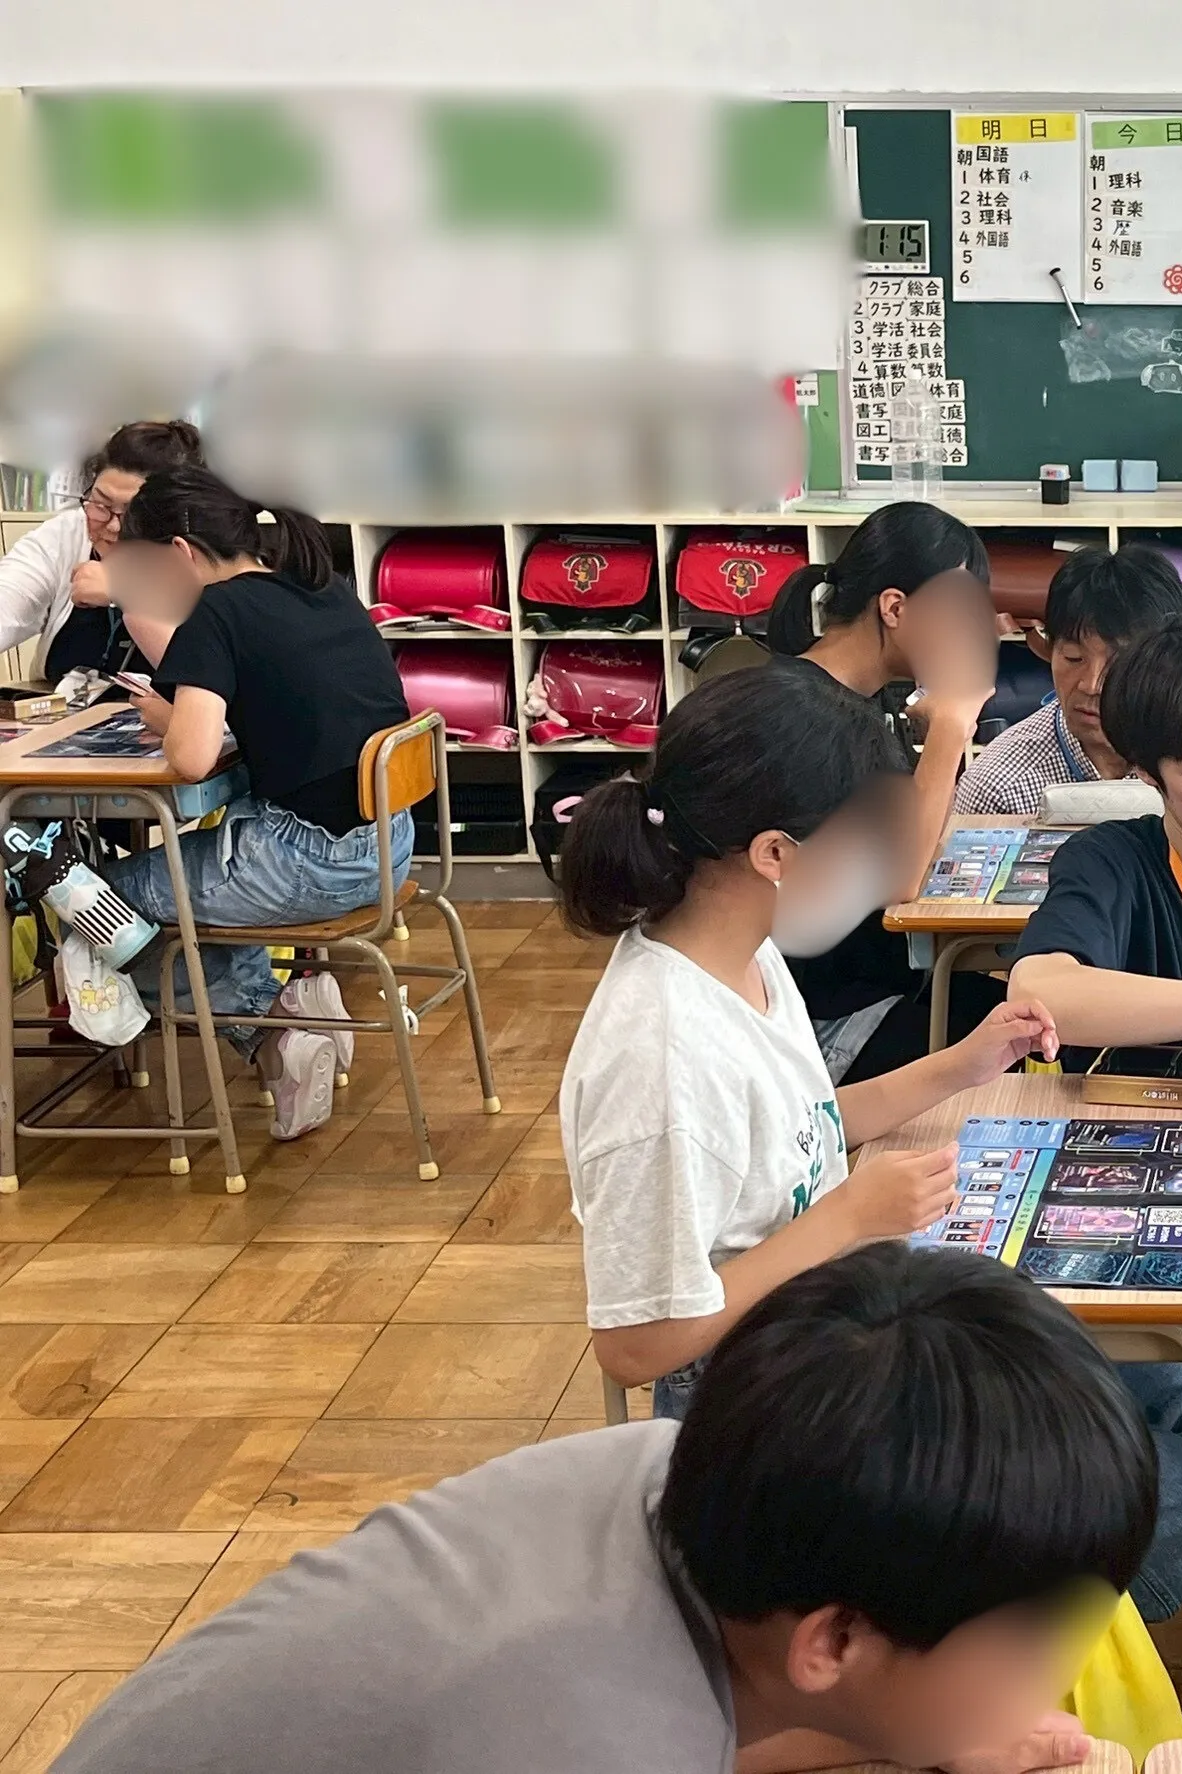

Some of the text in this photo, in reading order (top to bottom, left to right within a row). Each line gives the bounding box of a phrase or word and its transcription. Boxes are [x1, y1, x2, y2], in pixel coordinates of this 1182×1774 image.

[957, 146, 1010, 166] 朝 国語
[1090, 155, 1105, 171] 朝
[979, 168, 1011, 184] 体育
[1109, 171, 1142, 190] 理科
[960, 191, 1010, 207] 2 社会
[1091, 198, 1143, 217] 2 音楽
[961, 209, 1013, 225] 3 理科
[1093, 218, 1103, 232] 3
[959, 231, 1010, 248] 4 外国語
[1092, 237, 1142, 257] 4 外国語
[963, 250, 973, 264] 5
[1092, 258, 1101, 272] 5
[960, 270, 970, 283] 6
[1094, 276, 1104, 290] 6
[869, 280, 940, 296] クラブ 総合
[871, 301, 904, 317] クラブ
[909, 301, 941, 317] 家庭
[854, 320, 942, 338] 3 学活 社会
[853, 340, 944, 359] 3 学活 委員会
[857, 361, 868, 374] 4
[874, 363, 907, 380] 算数
[853, 383, 886, 399] 道徳
[929, 382, 960, 398] 体育
[856, 402, 889, 419] 書写
[856, 423, 888, 438] 図工
[858, 445, 889, 462] 書写
